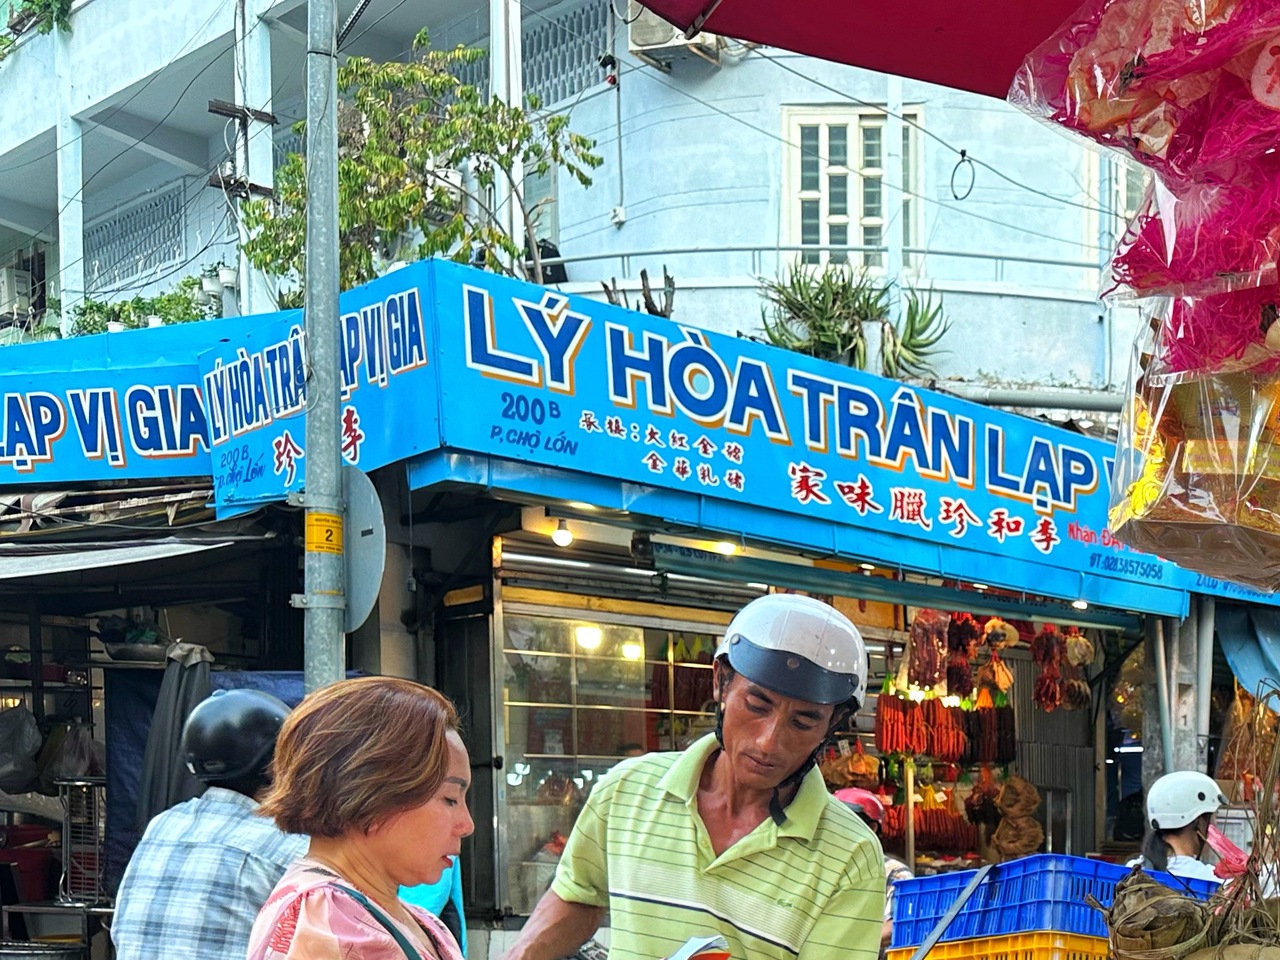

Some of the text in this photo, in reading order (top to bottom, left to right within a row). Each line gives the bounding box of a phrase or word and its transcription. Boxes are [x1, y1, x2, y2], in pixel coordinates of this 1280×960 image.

[0, 384, 210, 472] ẠP VỊ GIA
[203, 358, 230, 446] LÝ
[227, 348, 272, 436] HÒA
[266, 324, 308, 420] TRÂ
[362, 302, 387, 388] VỊ
[384, 287, 428, 376] GIA
[462, 283, 1098, 515] LÝ HÒA TRÂN LẠP
[325, 529, 333, 542] 2
